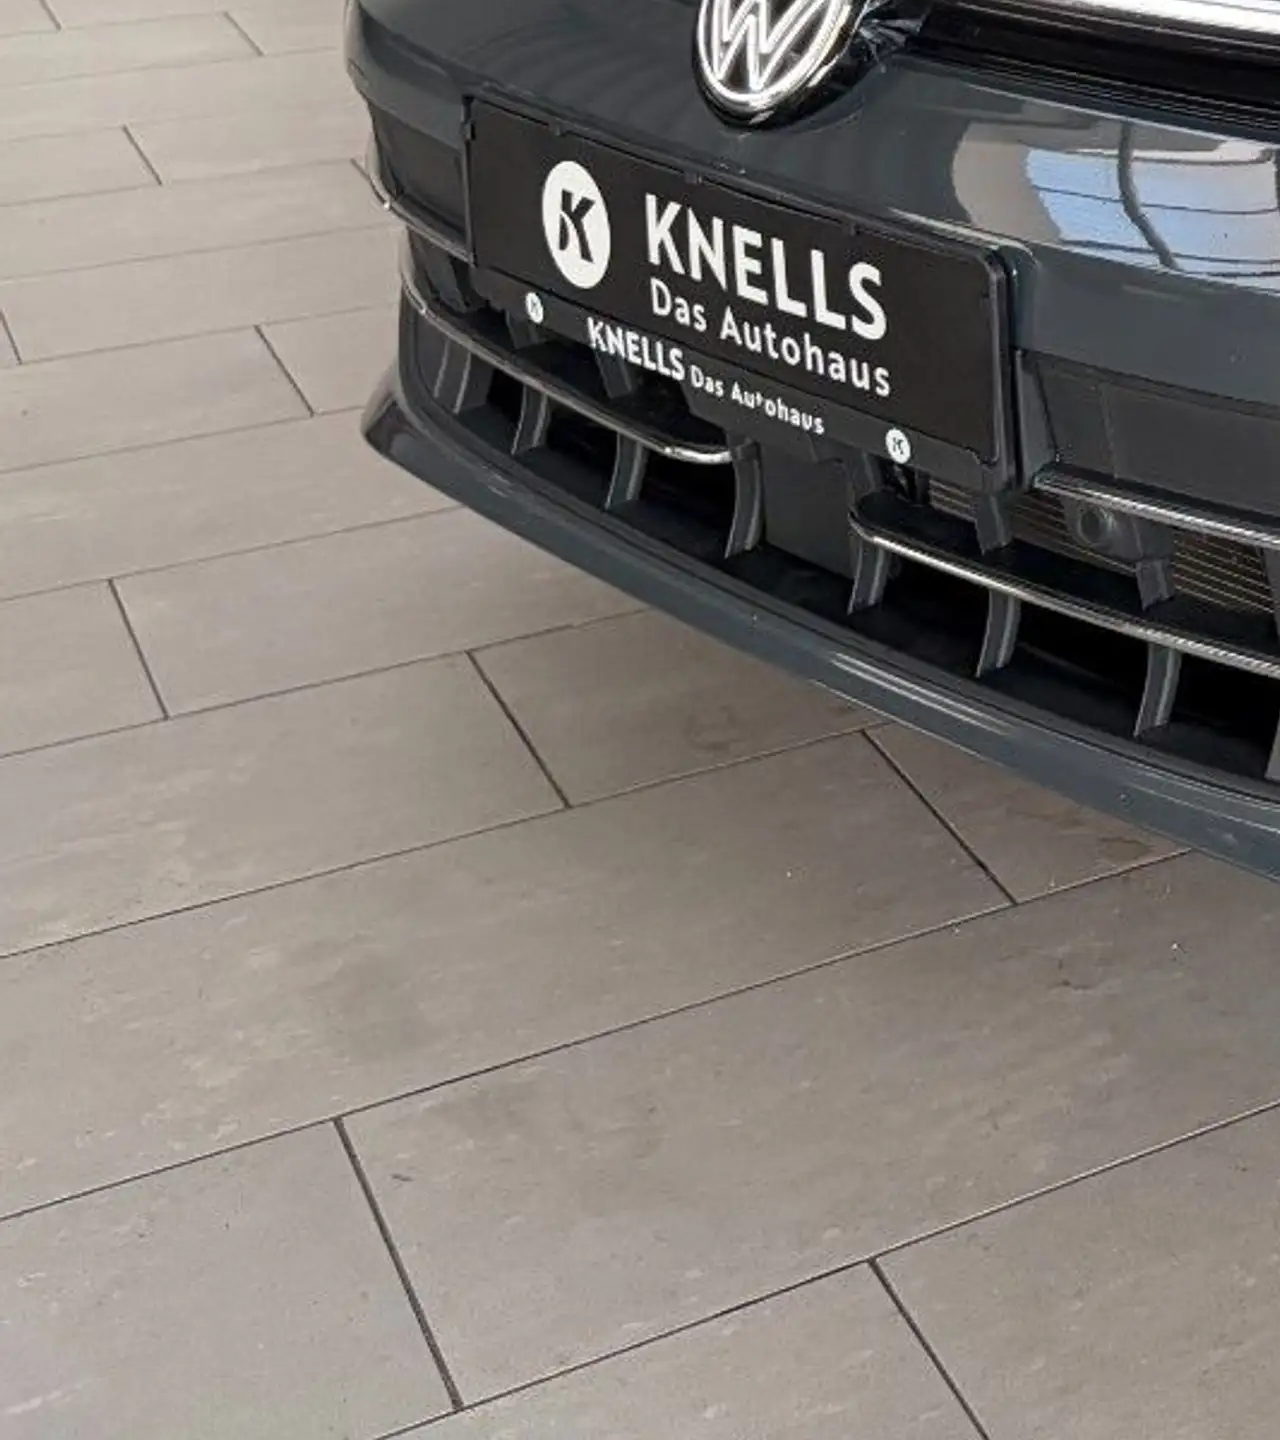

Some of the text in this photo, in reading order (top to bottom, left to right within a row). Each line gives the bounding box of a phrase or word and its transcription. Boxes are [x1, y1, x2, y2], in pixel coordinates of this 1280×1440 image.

[645, 192, 887, 340] KNELLS
[587, 316, 826, 436] KNELLS Das Autohaus
[650, 277, 891, 397] Das Autohaus
